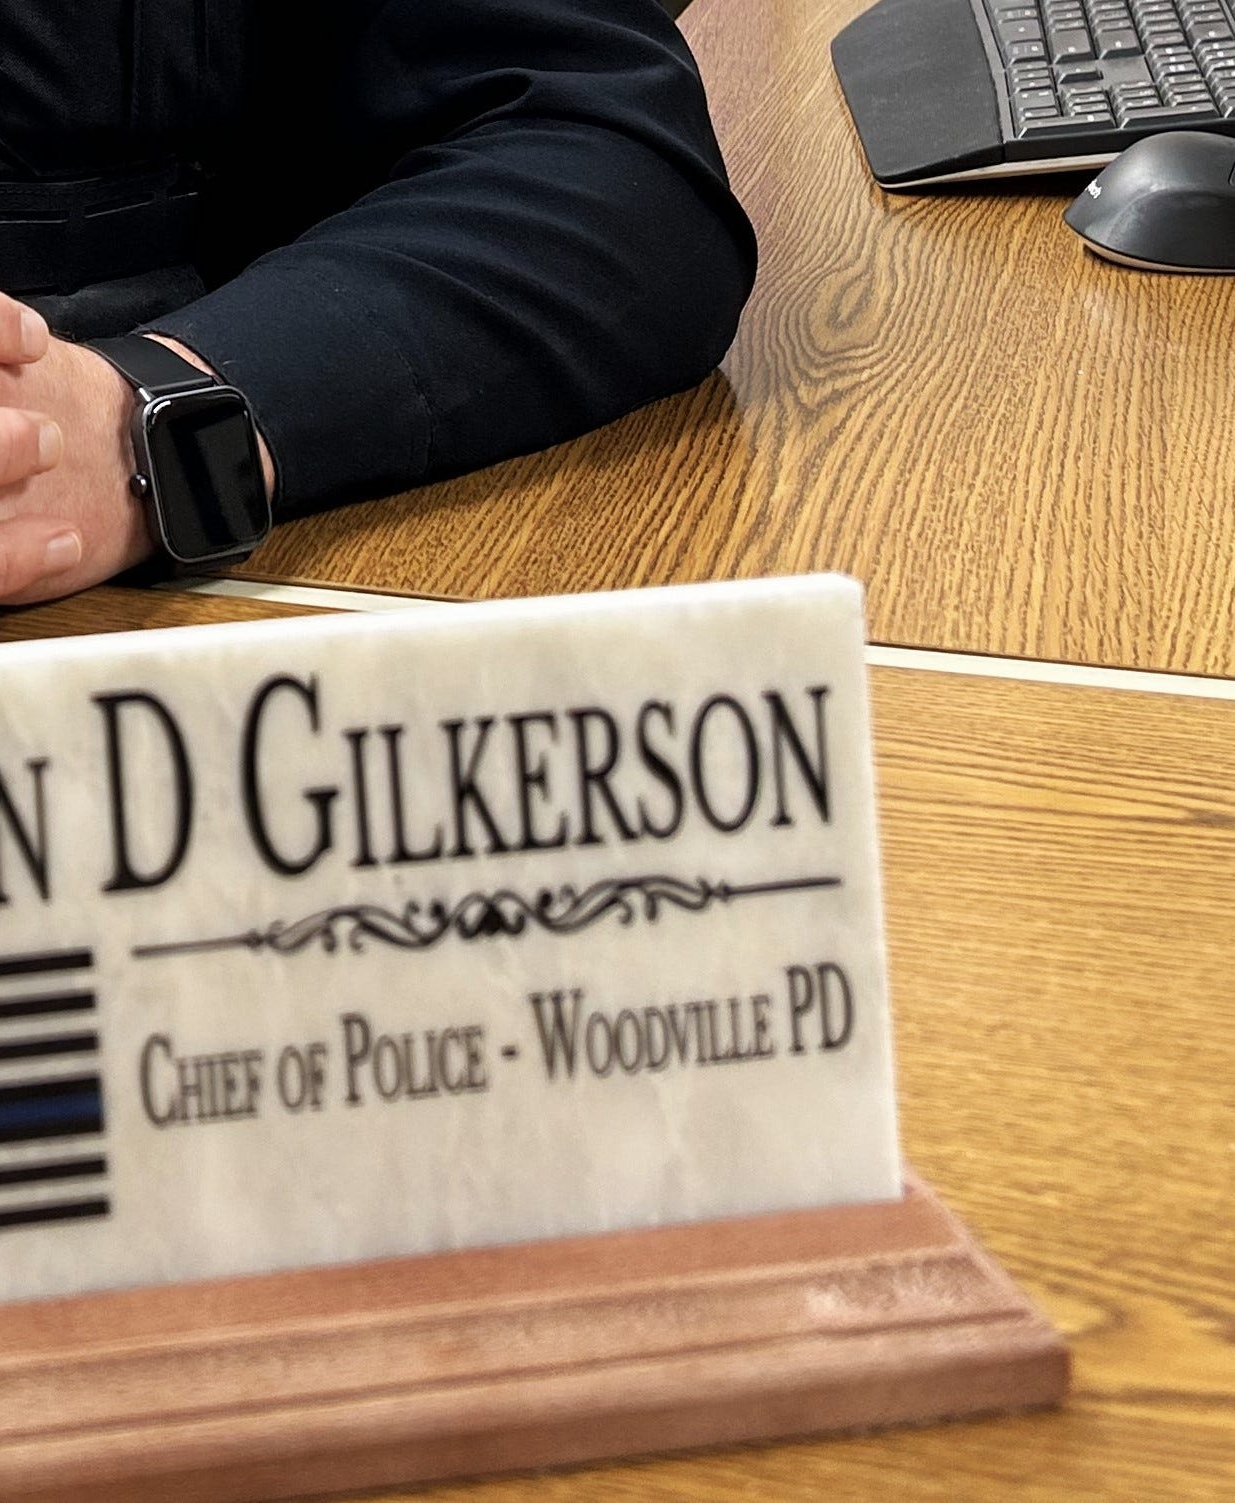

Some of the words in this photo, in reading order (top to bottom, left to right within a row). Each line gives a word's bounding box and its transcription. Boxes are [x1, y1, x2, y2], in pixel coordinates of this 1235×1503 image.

[89, 687, 197, 896] D
[239, 672, 832, 877] GILKERSON
[138, 1031, 266, 1128] CHIEF
[276, 1042, 331, 1112] OF
[339, 1011, 490, 1109] POLICE
[528, 987, 777, 1081] WOODVILLE
[784, 960, 855, 1056] PD
